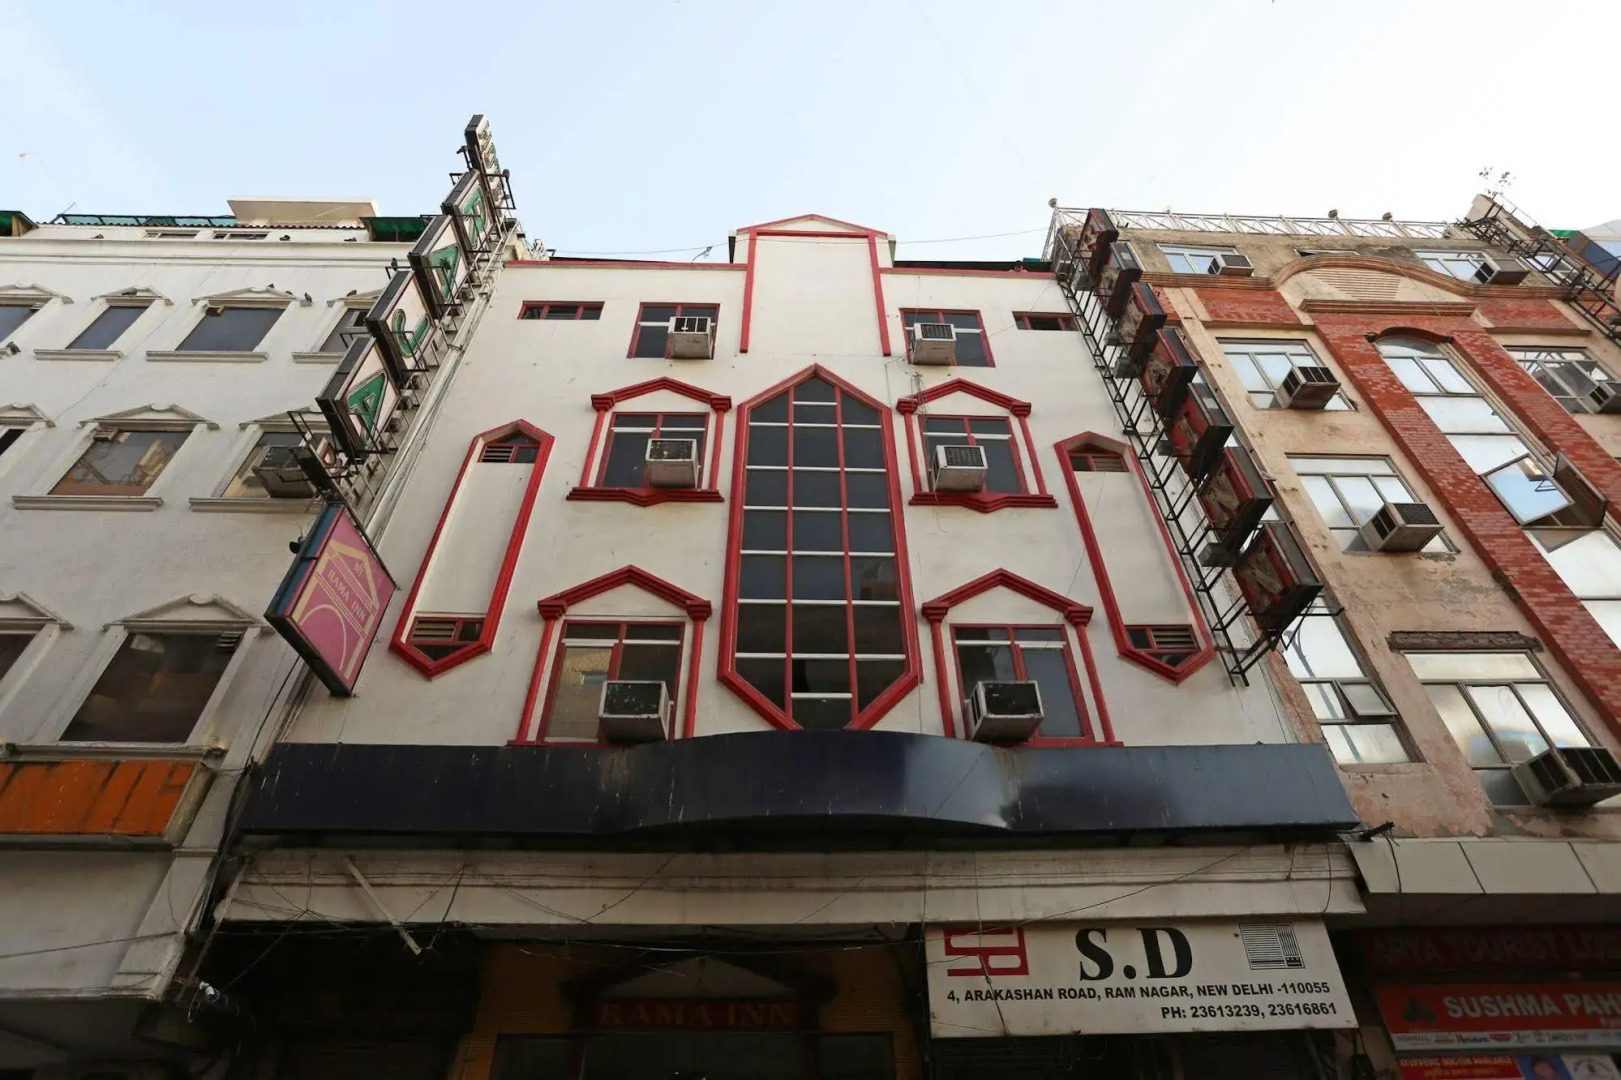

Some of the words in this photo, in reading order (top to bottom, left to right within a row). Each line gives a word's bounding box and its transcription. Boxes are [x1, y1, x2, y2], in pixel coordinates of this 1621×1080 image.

[327, 569, 350, 602] RAMA
[351, 600, 367, 622] INN
[1074, 926, 1194, 982] S.D
[946, 989, 961, 1004] 4,
[964, 987, 1054, 1002] ARAKASHAN
[1057, 985, 1102, 1003] ROAD,
[1105, 985, 1137, 1000] RAM
[1139, 984, 1194, 1000] NAGAR,
[1197, 983, 1229, 998] NEW
[1231, 982, 1275, 997] DELHI
[1277, 981, 1331, 996] -110055
[599, 1002, 713, 1027] RAMA
[726, 1002, 798, 1026] INN
[1160, 1003, 1188, 1020] PH:
[1190, 1003, 1266, 1020] 23613239,
[1269, 1001, 1338, 1018] 23616861
[1442, 994, 1563, 1018] SUSHMA
[1564, 993, 1621, 1017] PAH
